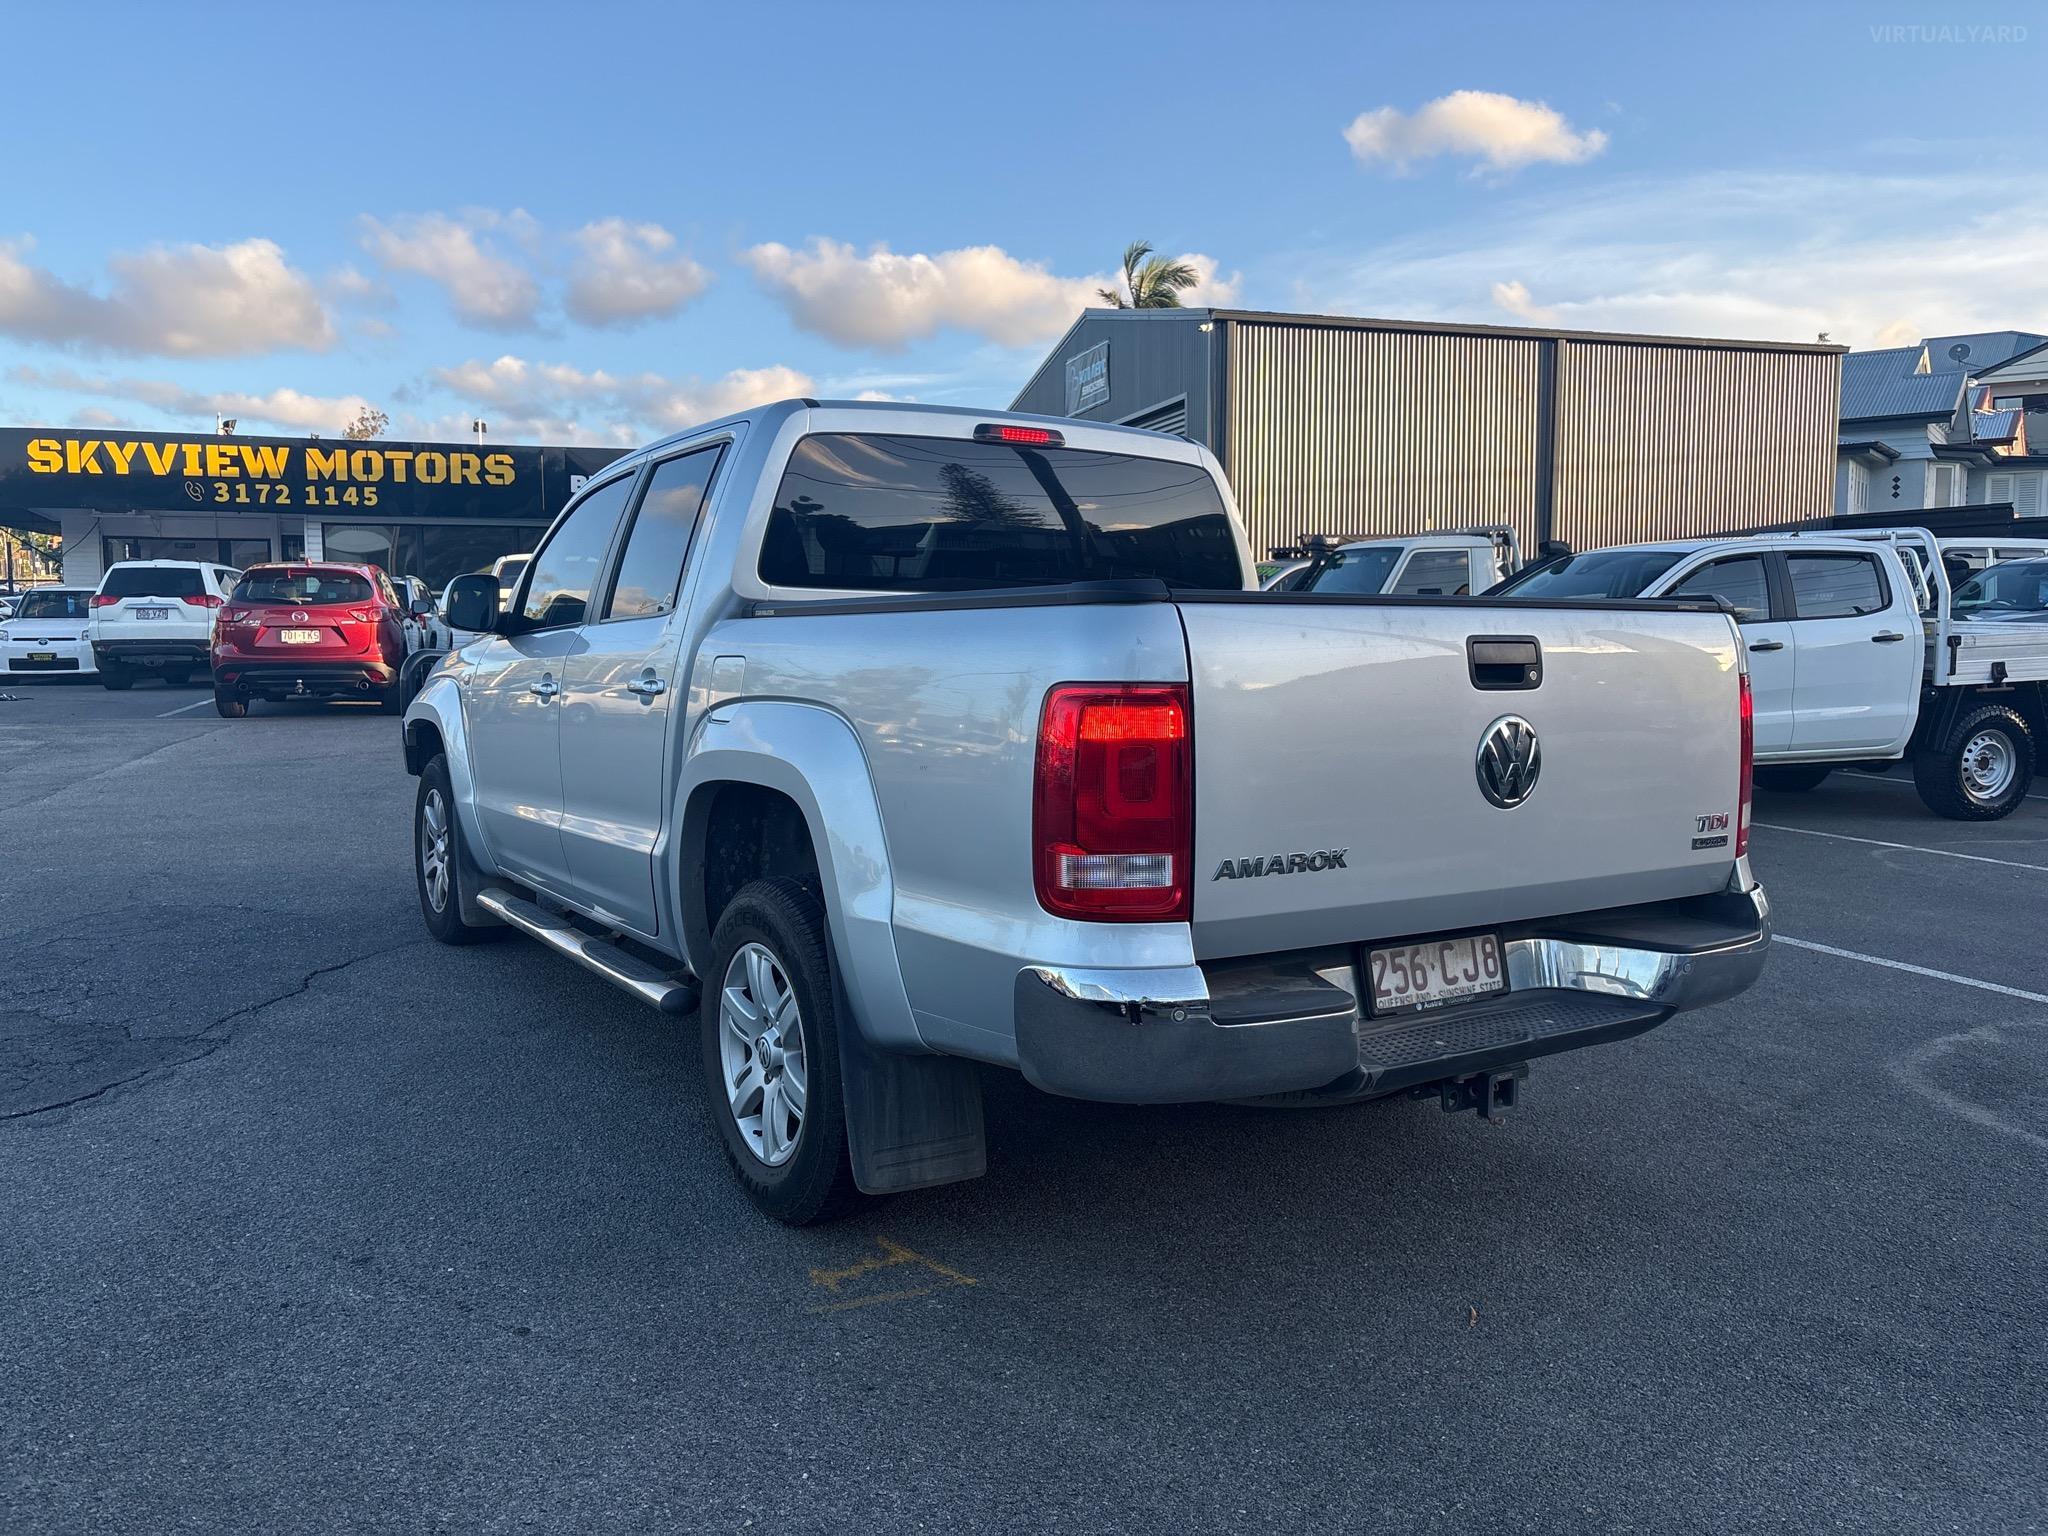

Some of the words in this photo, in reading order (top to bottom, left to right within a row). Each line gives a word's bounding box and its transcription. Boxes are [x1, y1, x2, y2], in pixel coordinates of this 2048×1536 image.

[27, 438, 290, 479] SKYVIEW
[305, 447, 516, 486] MOTORS
[214, 481, 291, 505] 3172
[305, 485, 379, 506] 1145
[1696, 812, 1729, 832] TDI
[1211, 847, 1349, 881] AMAROK
[1439, 983, 1476, 1000] SUNSHINE
